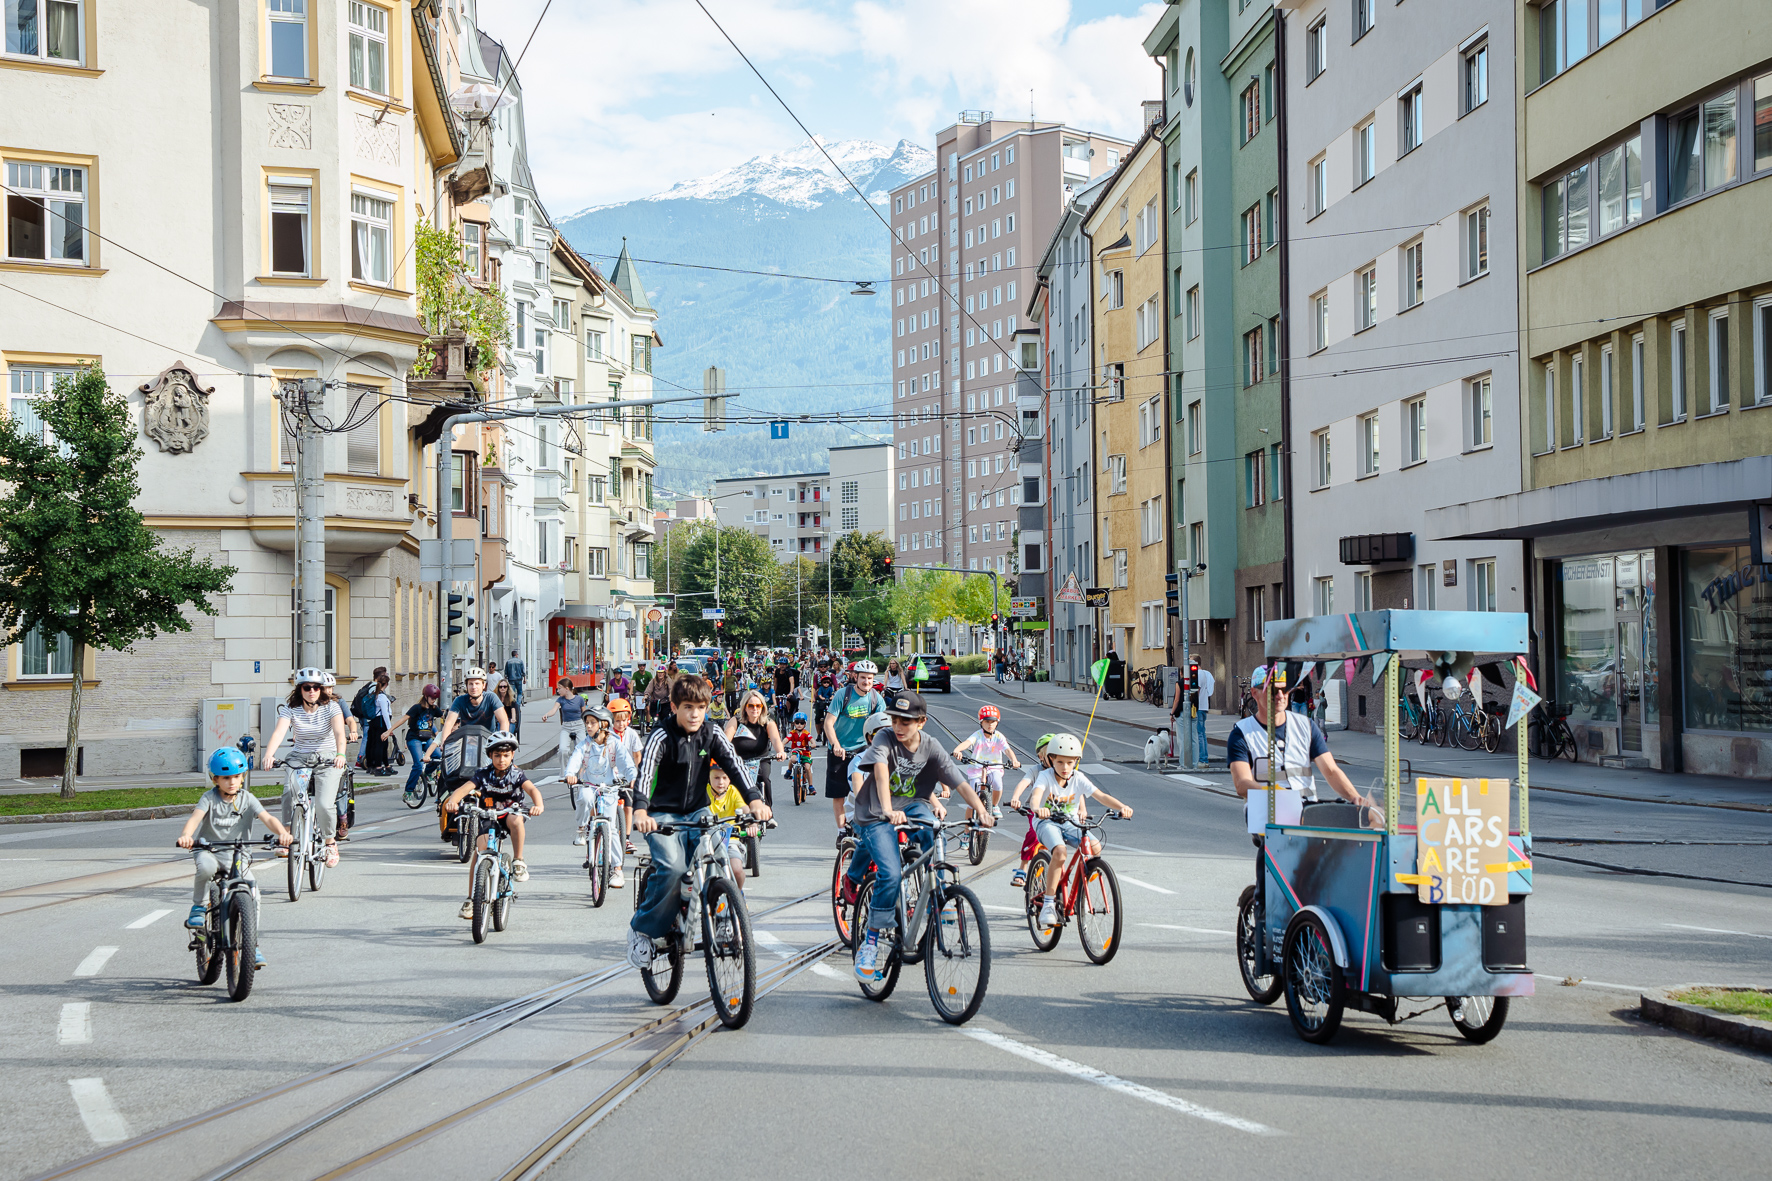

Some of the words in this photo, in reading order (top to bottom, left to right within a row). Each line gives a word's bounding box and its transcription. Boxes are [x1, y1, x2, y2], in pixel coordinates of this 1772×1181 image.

[775, 423, 785, 437] T
[1086, 592, 1106, 601] Burger
[1701, 564, 1753, 615] Time
[1421, 784, 1482, 816] ALL
[1420, 816, 1503, 848] CARS
[1422, 847, 1480, 875] ARE
[1429, 875, 1496, 904] BLÖD
